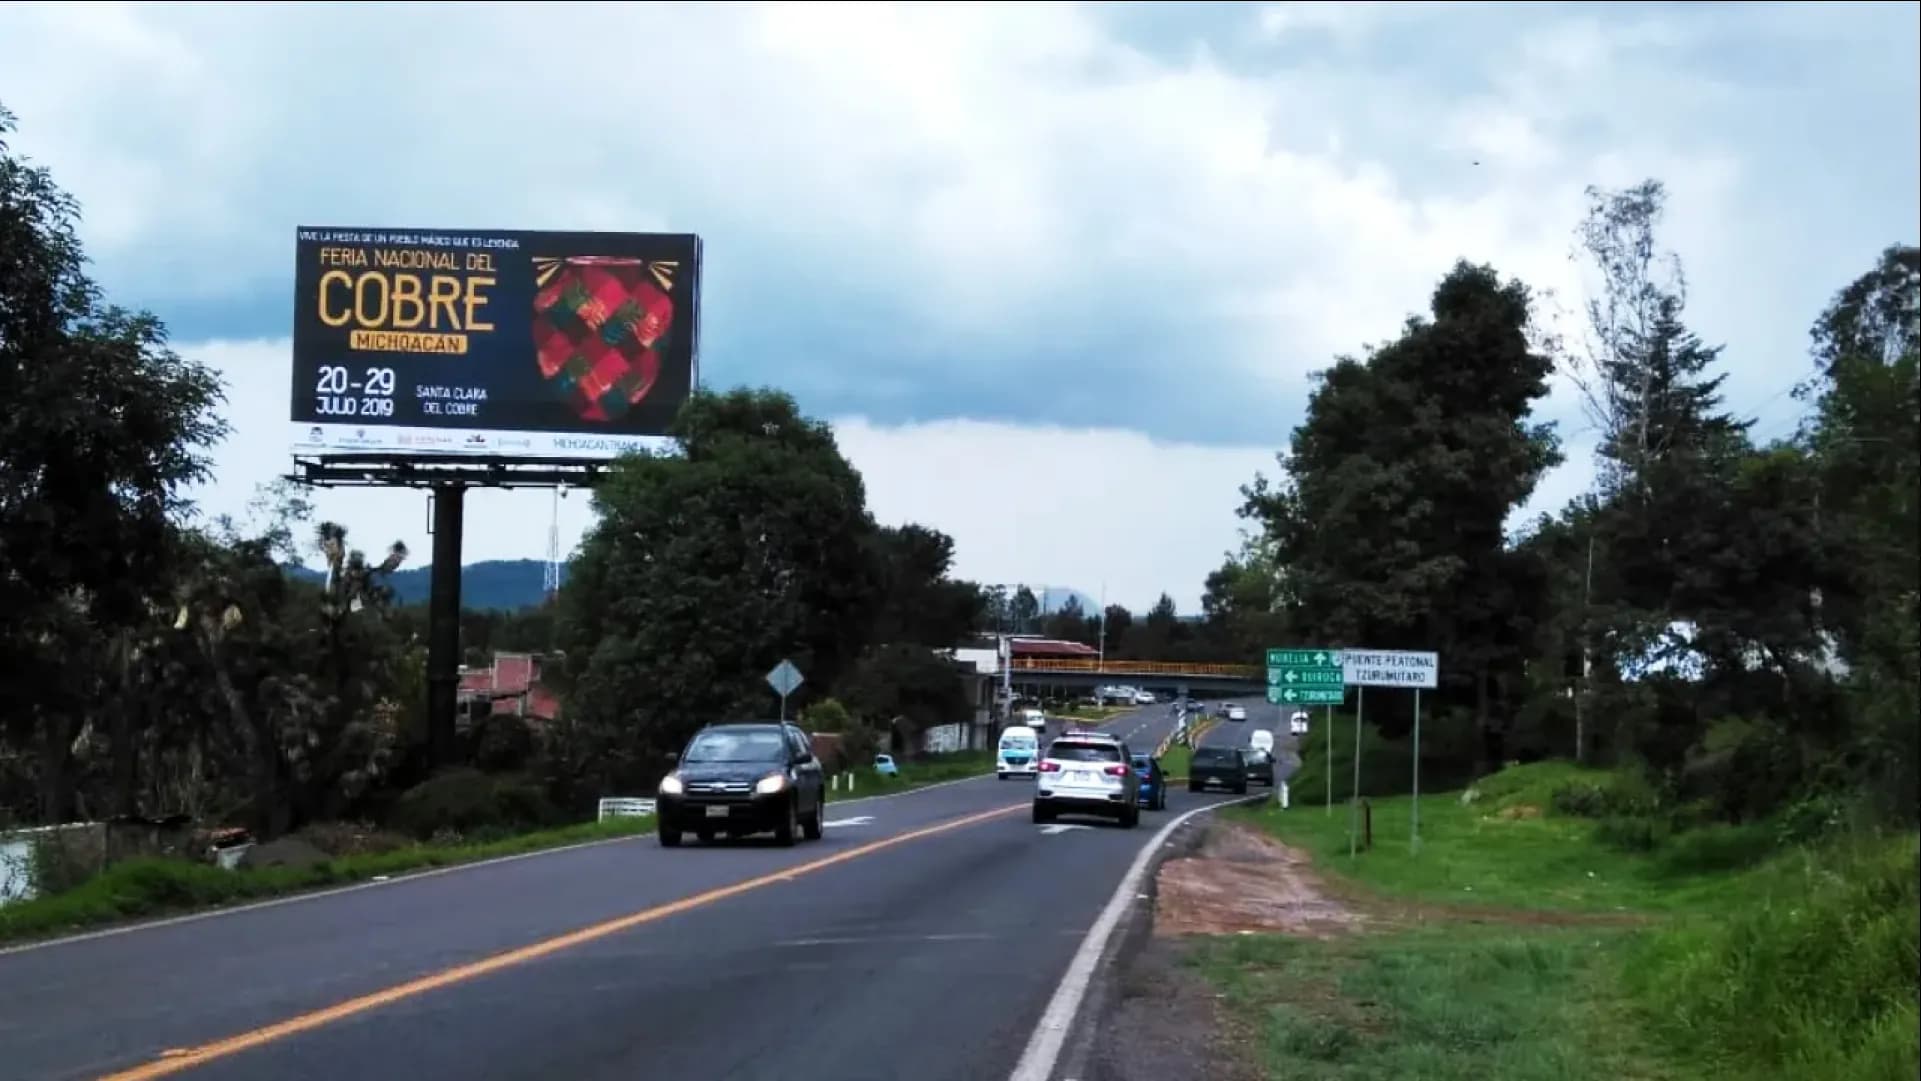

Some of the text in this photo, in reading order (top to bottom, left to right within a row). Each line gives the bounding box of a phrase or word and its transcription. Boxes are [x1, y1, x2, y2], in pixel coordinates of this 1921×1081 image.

[320, 247, 497, 272] FERIA NACIONAL DEL
[318, 270, 497, 331] COBRE
[416, 384, 488, 401] SANTA CLARA
[315, 396, 395, 417] JULIO 2019
[423, 401, 479, 416] DEL COBRE
[1344, 652, 1382, 666] PUENTE
[1384, 654, 1434, 668] PEATONAL
